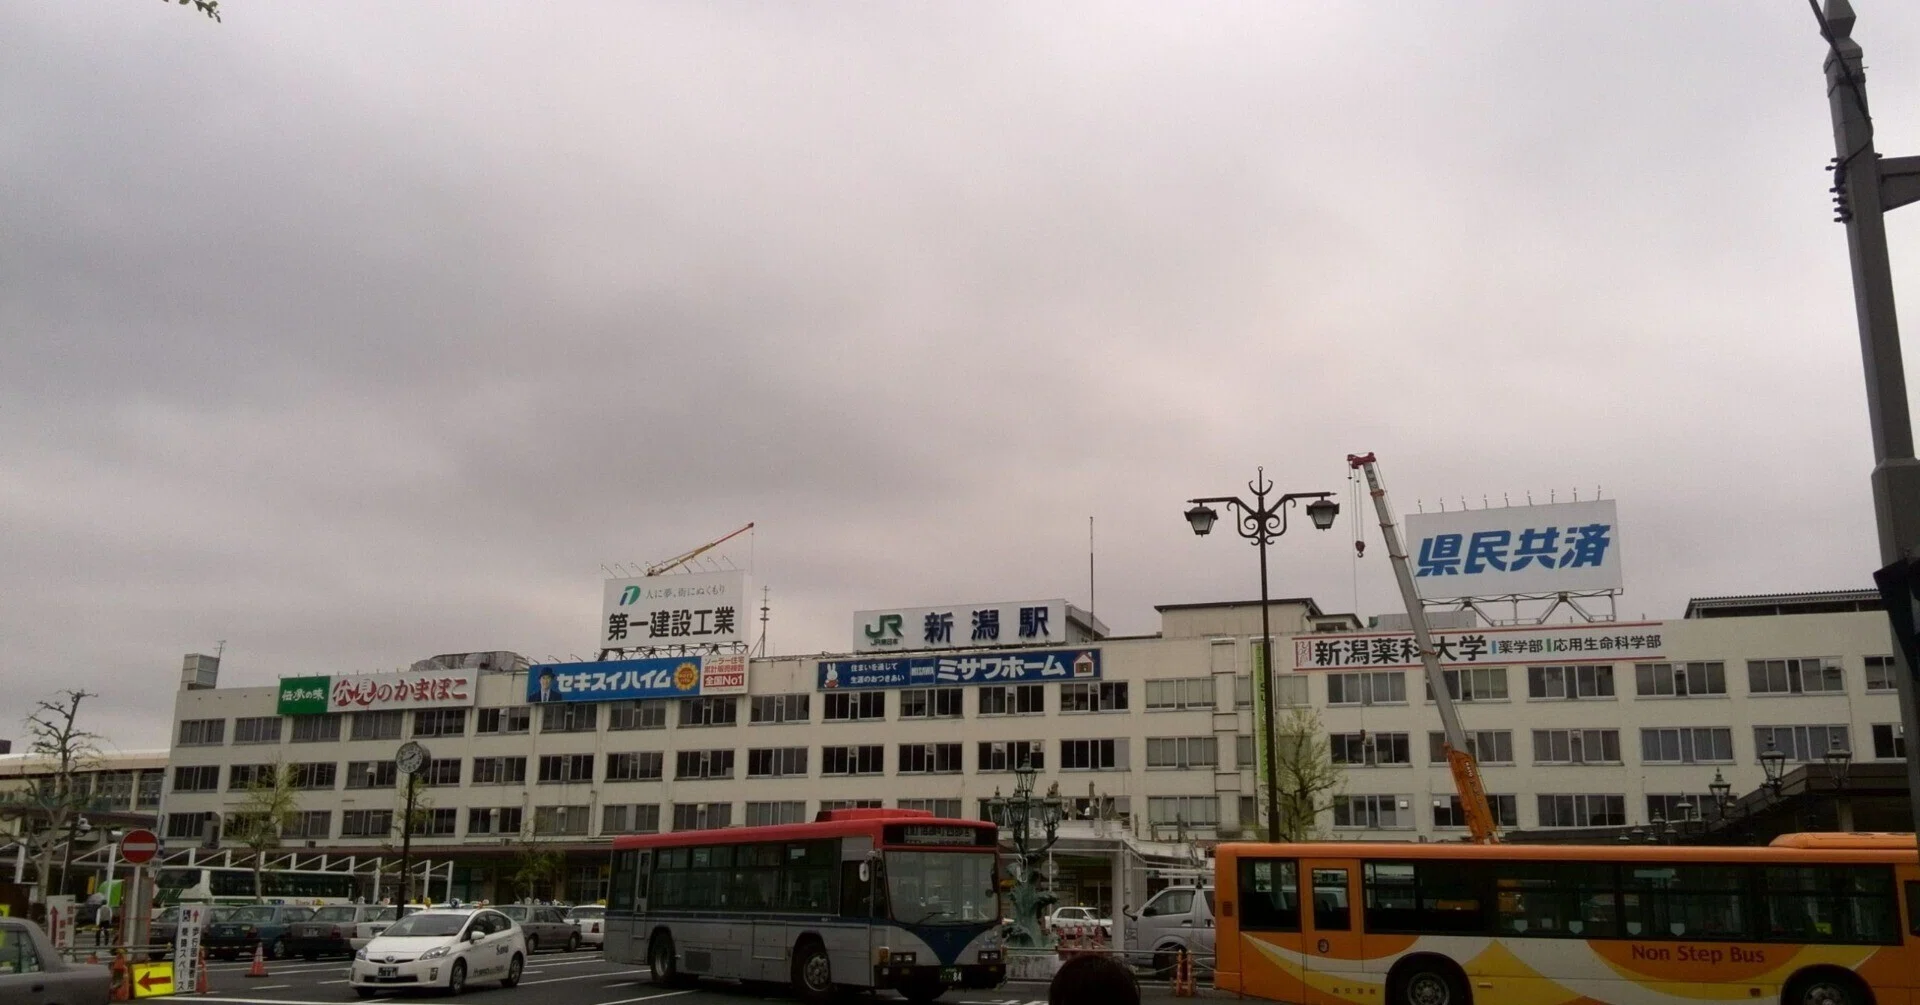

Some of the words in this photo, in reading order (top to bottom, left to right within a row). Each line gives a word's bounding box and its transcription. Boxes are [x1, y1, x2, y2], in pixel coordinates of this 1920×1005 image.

[1416, 523, 1611, 577] 県民共済
[608, 605, 735, 641] 第一建設工業
[865, 614, 903, 639] JR
[924, 606, 1050, 643] 新潟駅
[1315, 635, 1488, 666] 新潟薬科大学
[1498, 639, 1543, 654] 薬学部
[1553, 634, 1662, 652] 応用生命科学部
[704, 656, 744, 666] ソーラー住宅
[850, 662, 899, 673] 住まいを通じて
[937, 655, 1066, 681] ミサワホーム
[332, 677, 468, 706] 伏見のかまぼこ
[557, 668, 671, 693] セキスイハイム
[850, 674, 905, 685] 生活のおつきあい
[281, 688, 325, 702] 伝承の味
[1632, 944, 1670, 961] Non
[1677, 945, 1723, 965] Step
[1730, 946, 1765, 963] Bus
